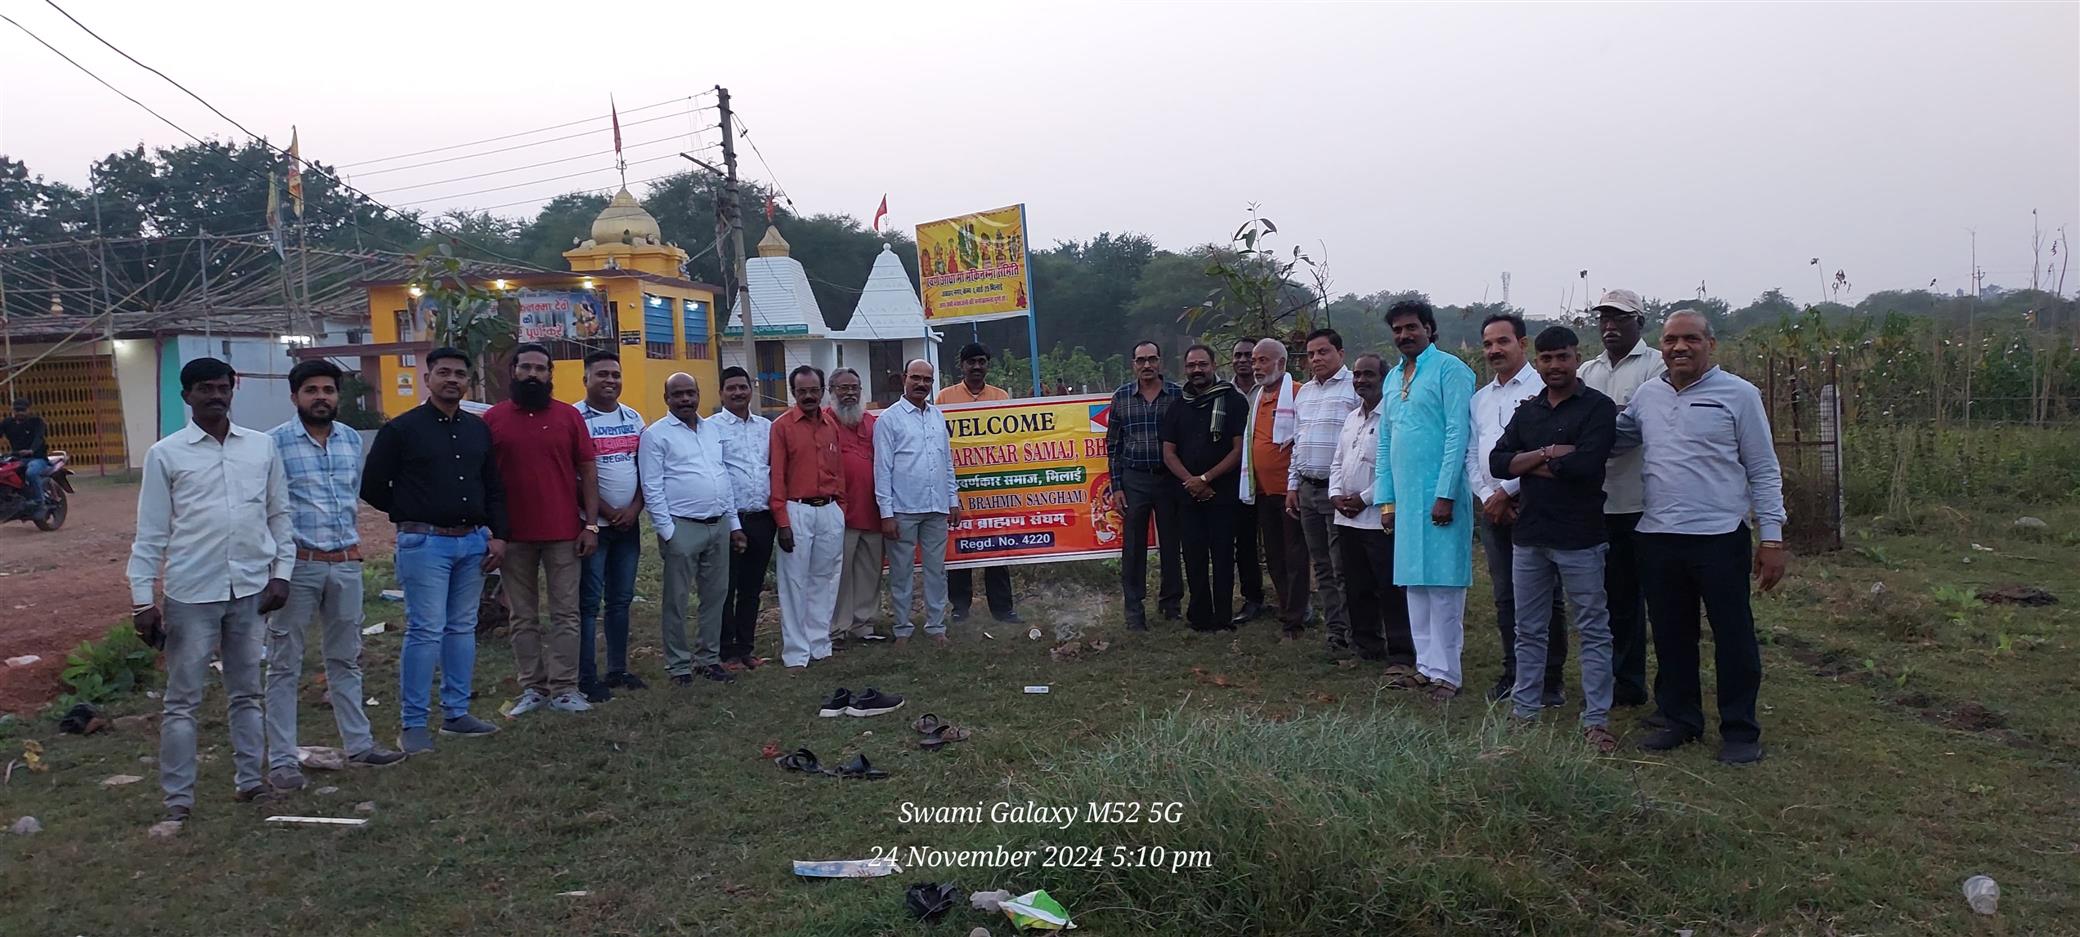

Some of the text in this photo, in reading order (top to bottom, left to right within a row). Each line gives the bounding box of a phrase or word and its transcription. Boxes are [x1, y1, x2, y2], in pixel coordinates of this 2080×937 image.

[592, 424, 636, 436] ADVENTURE
[1024, 439, 1079, 463] SAMAJ,
[1004, 473, 1042, 486] समाज,
[1046, 467, 1083, 483] भिलाई
[968, 494, 1022, 510] BRAHMIN
[1027, 490, 1087, 507] SANGHAM)
[960, 533, 1051, 551] Regd. No. 4220
